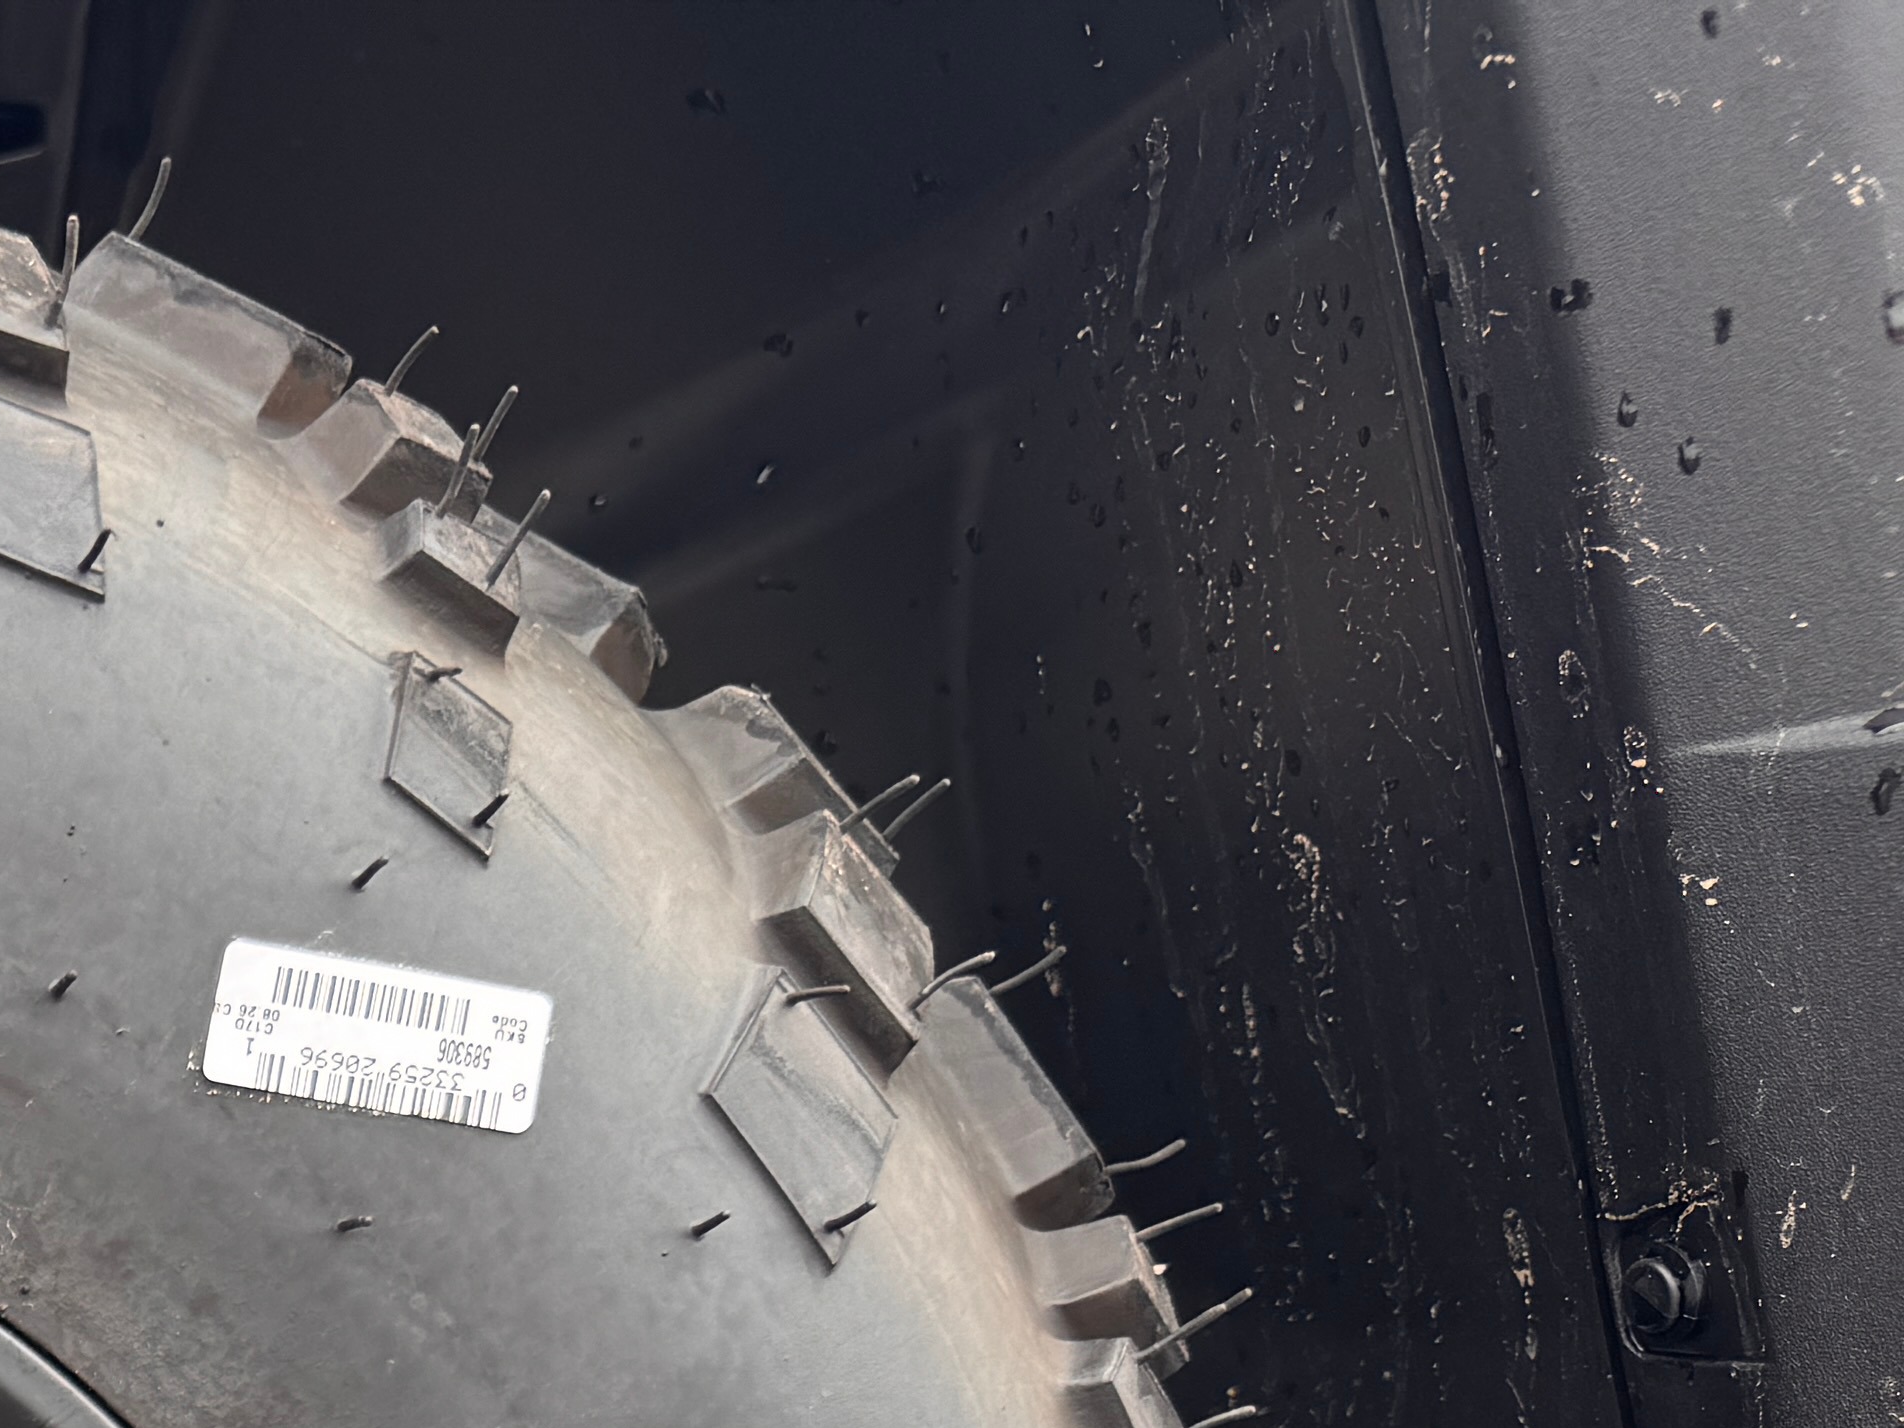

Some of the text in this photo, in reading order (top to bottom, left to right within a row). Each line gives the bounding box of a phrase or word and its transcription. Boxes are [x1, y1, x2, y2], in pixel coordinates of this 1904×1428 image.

[299, 1045, 377, 1077] 20696
[436, 1037, 493, 1071] 589306
[388, 1064, 466, 1093] 33259
